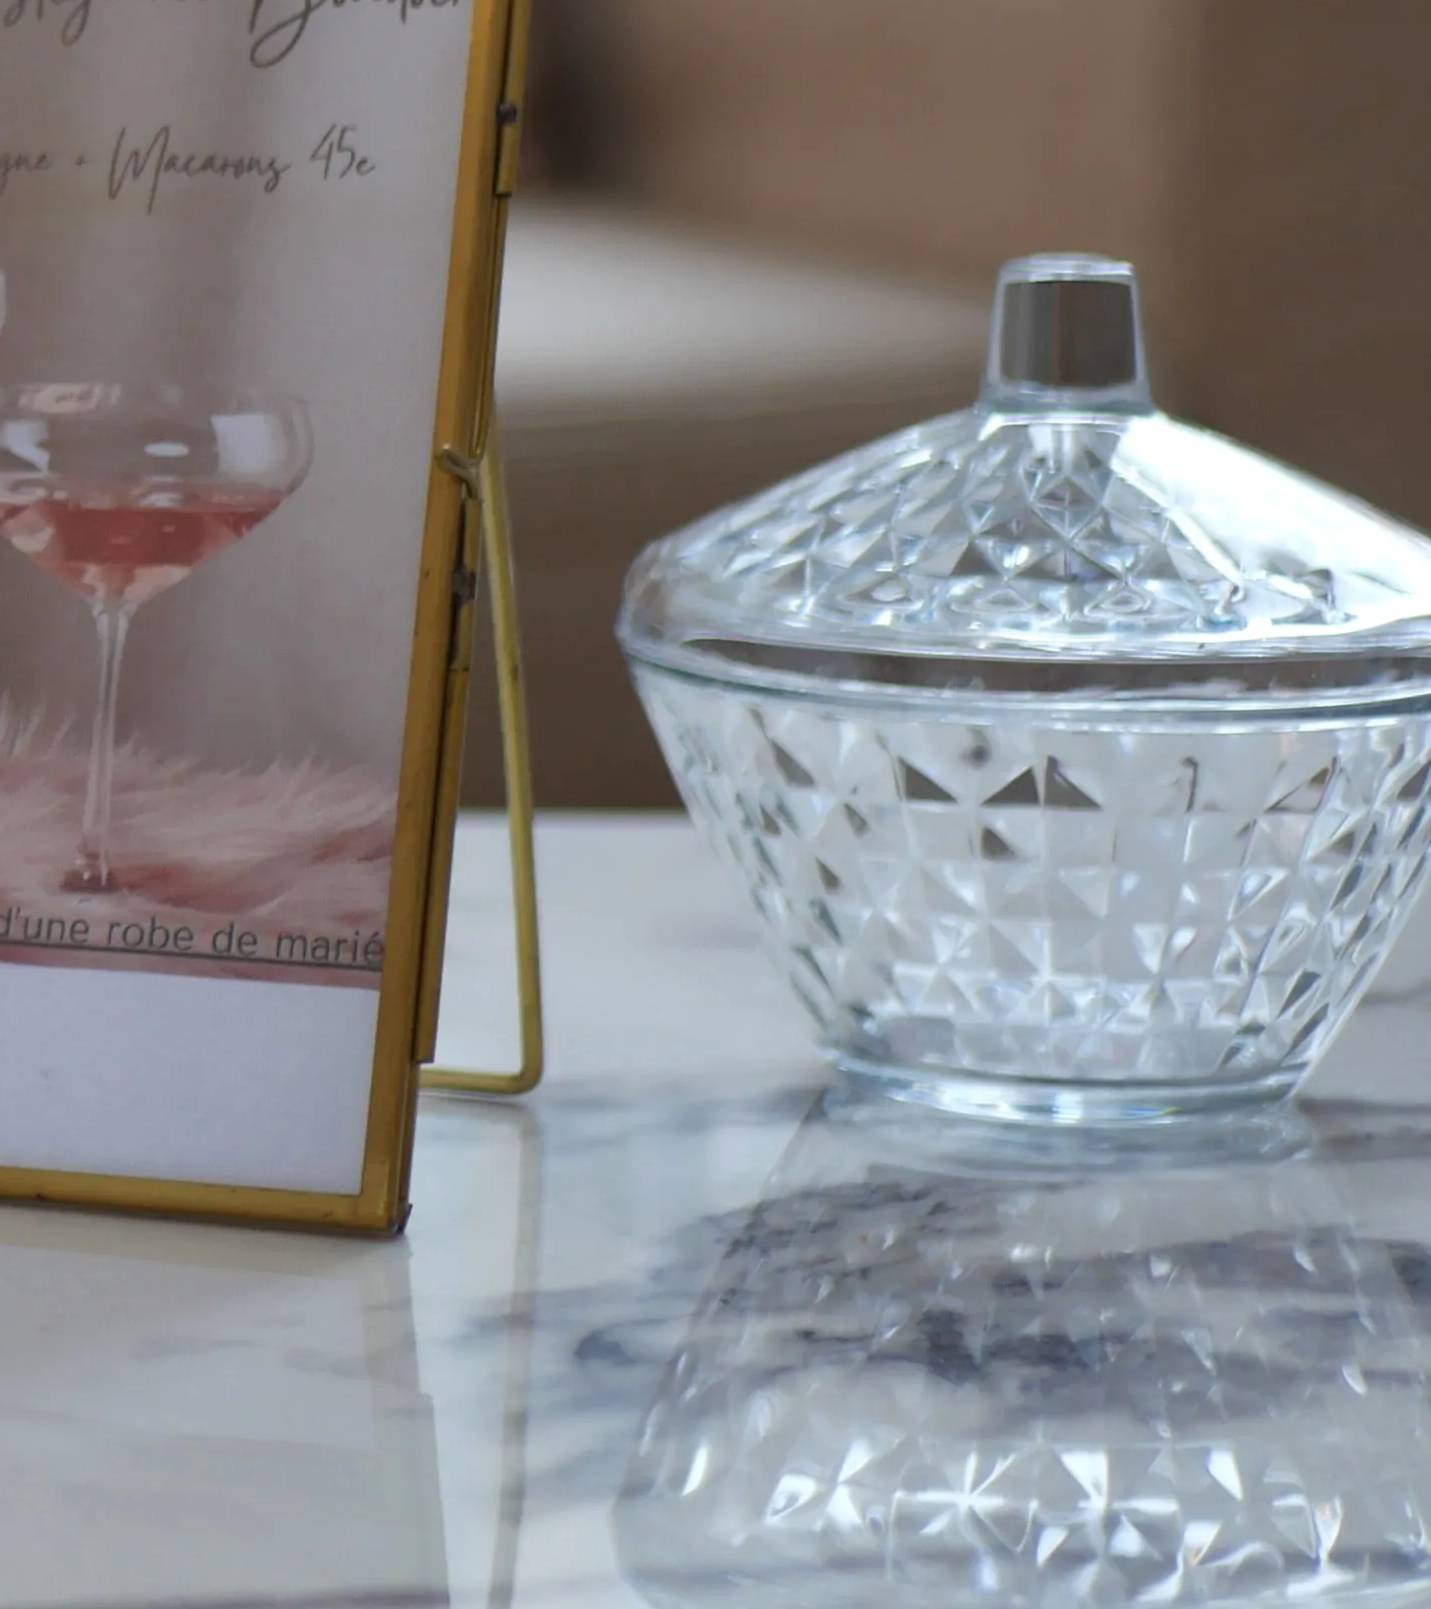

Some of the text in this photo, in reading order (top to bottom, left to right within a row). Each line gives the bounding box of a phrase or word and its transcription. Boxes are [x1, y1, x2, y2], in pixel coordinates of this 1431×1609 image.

[108, 125, 292, 214] Macarons
[106, 915, 195, 953] robe
[211, 922, 258, 957] de
